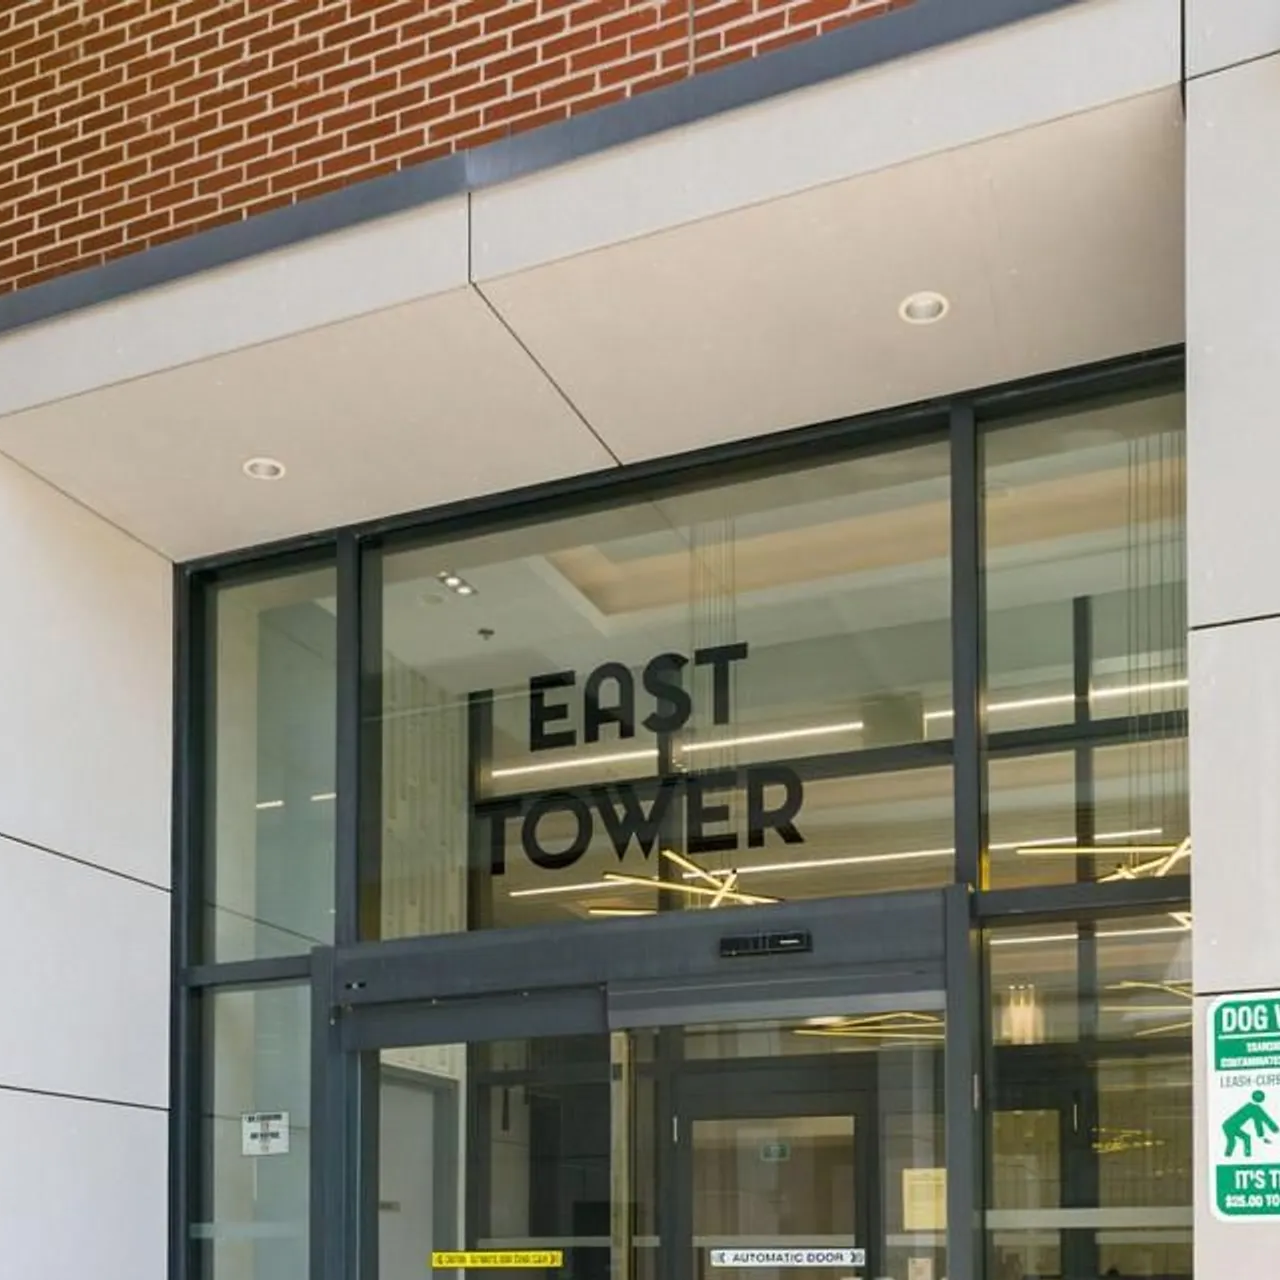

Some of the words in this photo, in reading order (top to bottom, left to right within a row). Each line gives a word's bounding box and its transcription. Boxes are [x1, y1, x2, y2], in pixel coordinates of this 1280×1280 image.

[529, 642, 748, 752] EAST
[475, 766, 805, 876] TOWER
[1222, 1004, 1268, 1032] DOG
[1235, 1169, 1266, 1189] IT'S
[1265, 1194, 1280, 1207] TO
[732, 1252, 804, 1263] AUTOMATIC
[806, 1252, 844, 1263] DOOR
